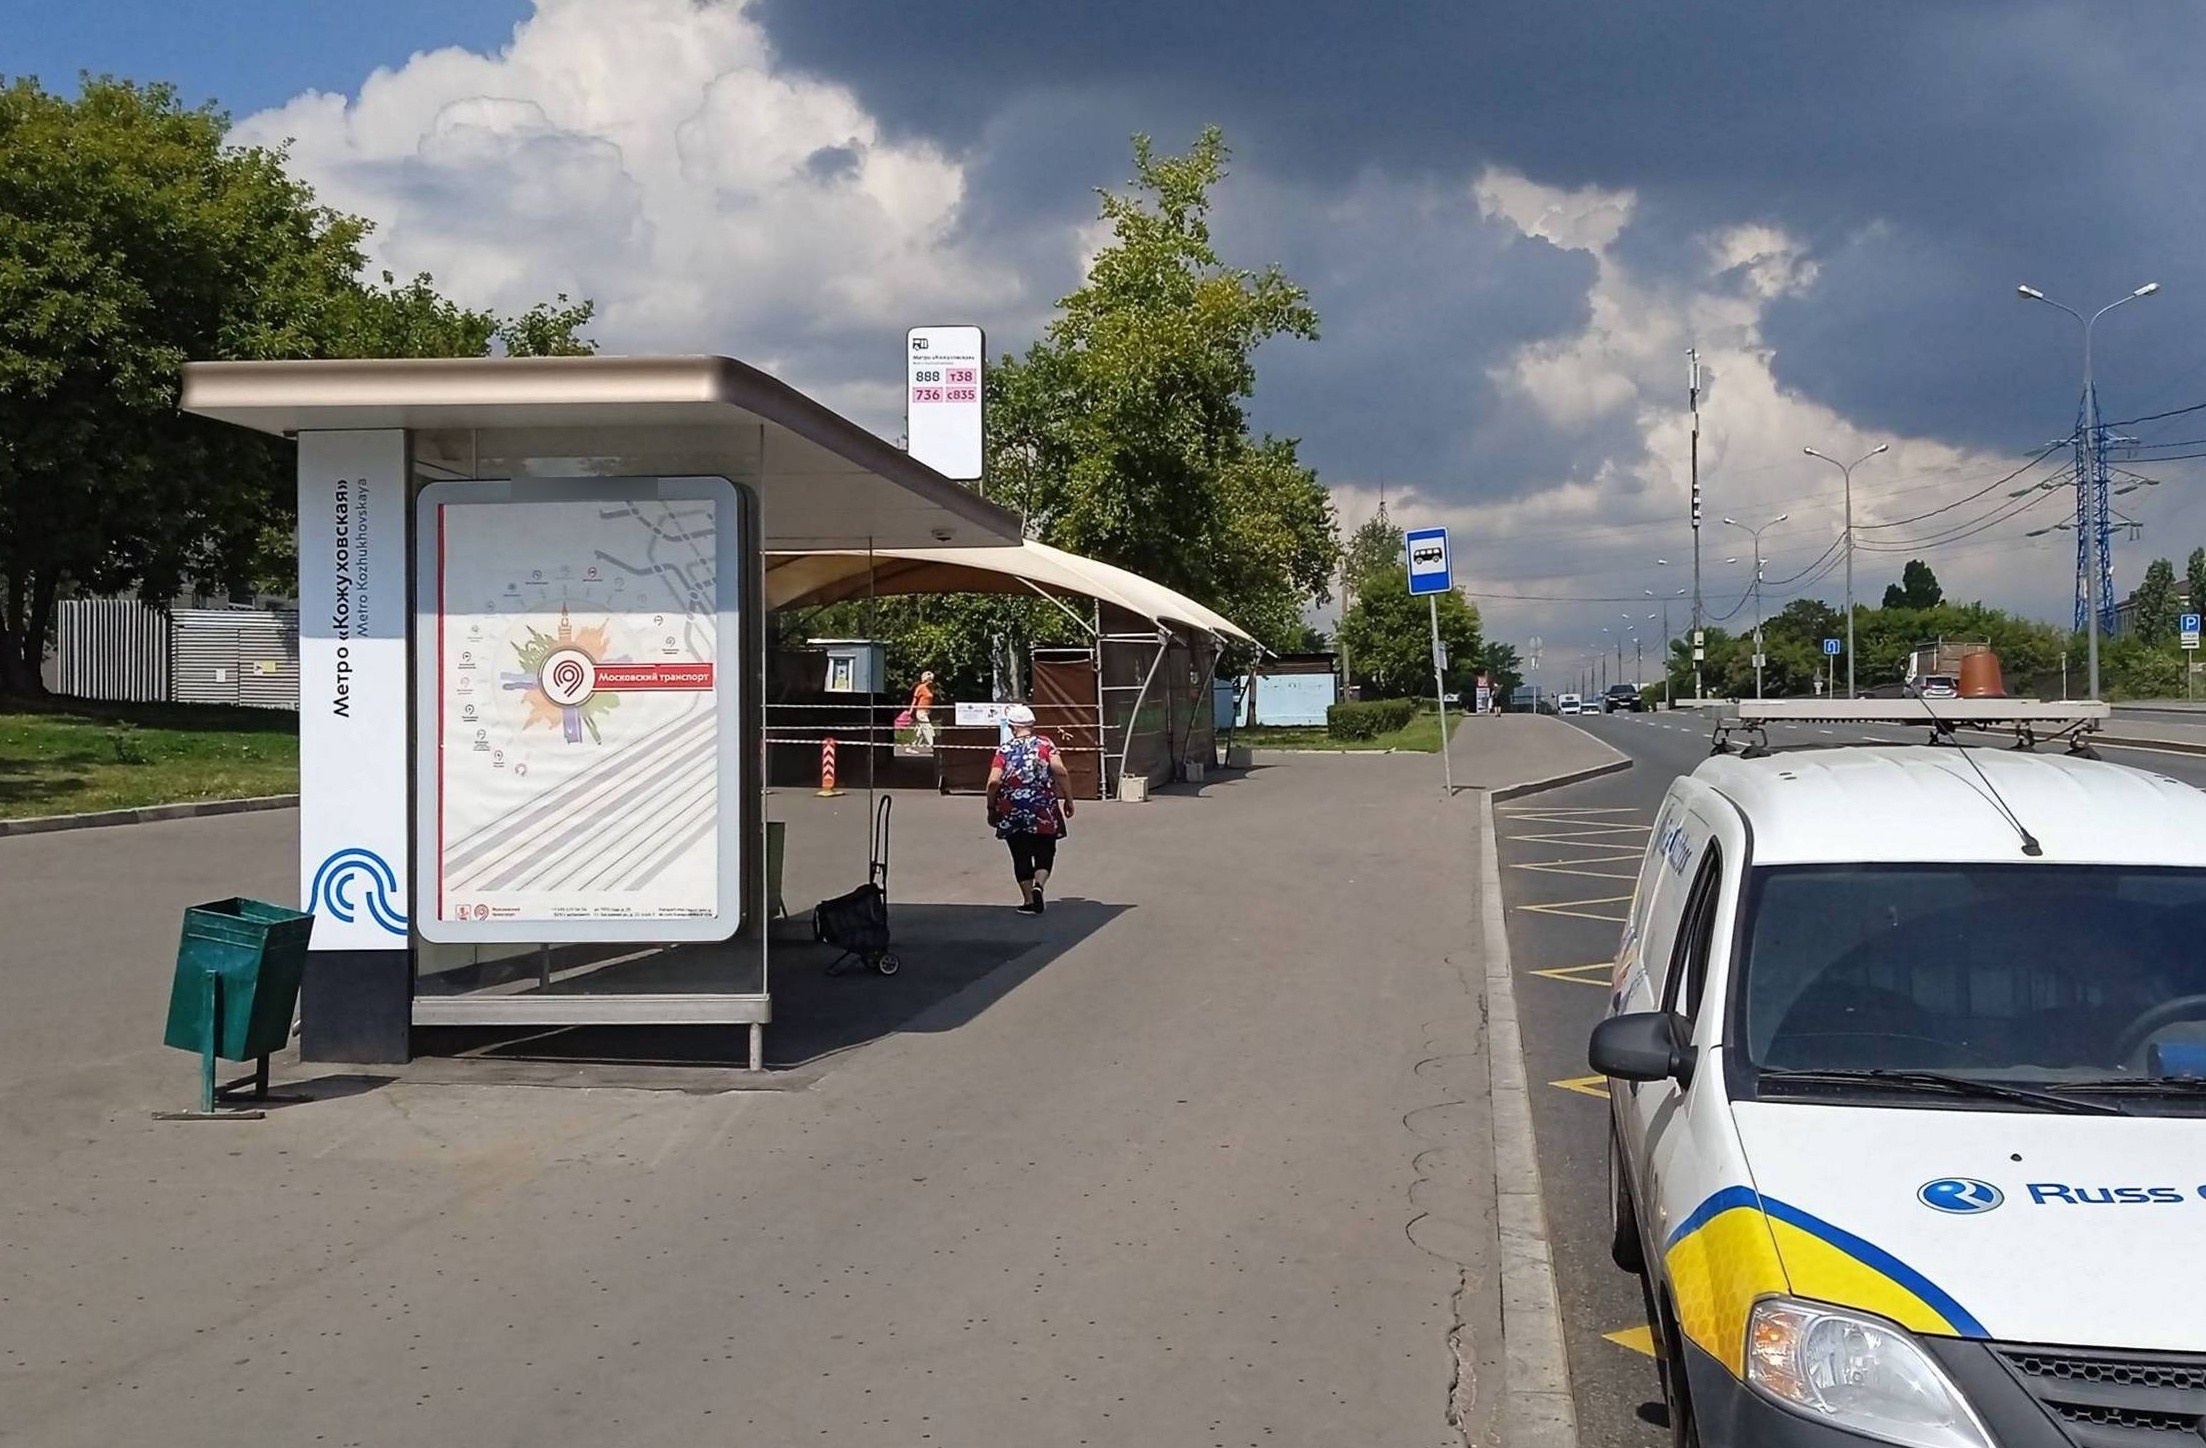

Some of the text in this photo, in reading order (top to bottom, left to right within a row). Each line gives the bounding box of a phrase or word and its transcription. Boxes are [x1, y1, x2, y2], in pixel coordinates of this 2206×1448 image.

[916, 371, 940, 382] 888
[916, 390, 940, 401] 736
[356, 478, 369, 637] Metro Kozhukhovskaya
[333, 478, 352, 718] Метро «Кожуховская»
[598, 672, 709, 682] Московский транспорт
[2026, 1183, 2185, 1204] Russ
